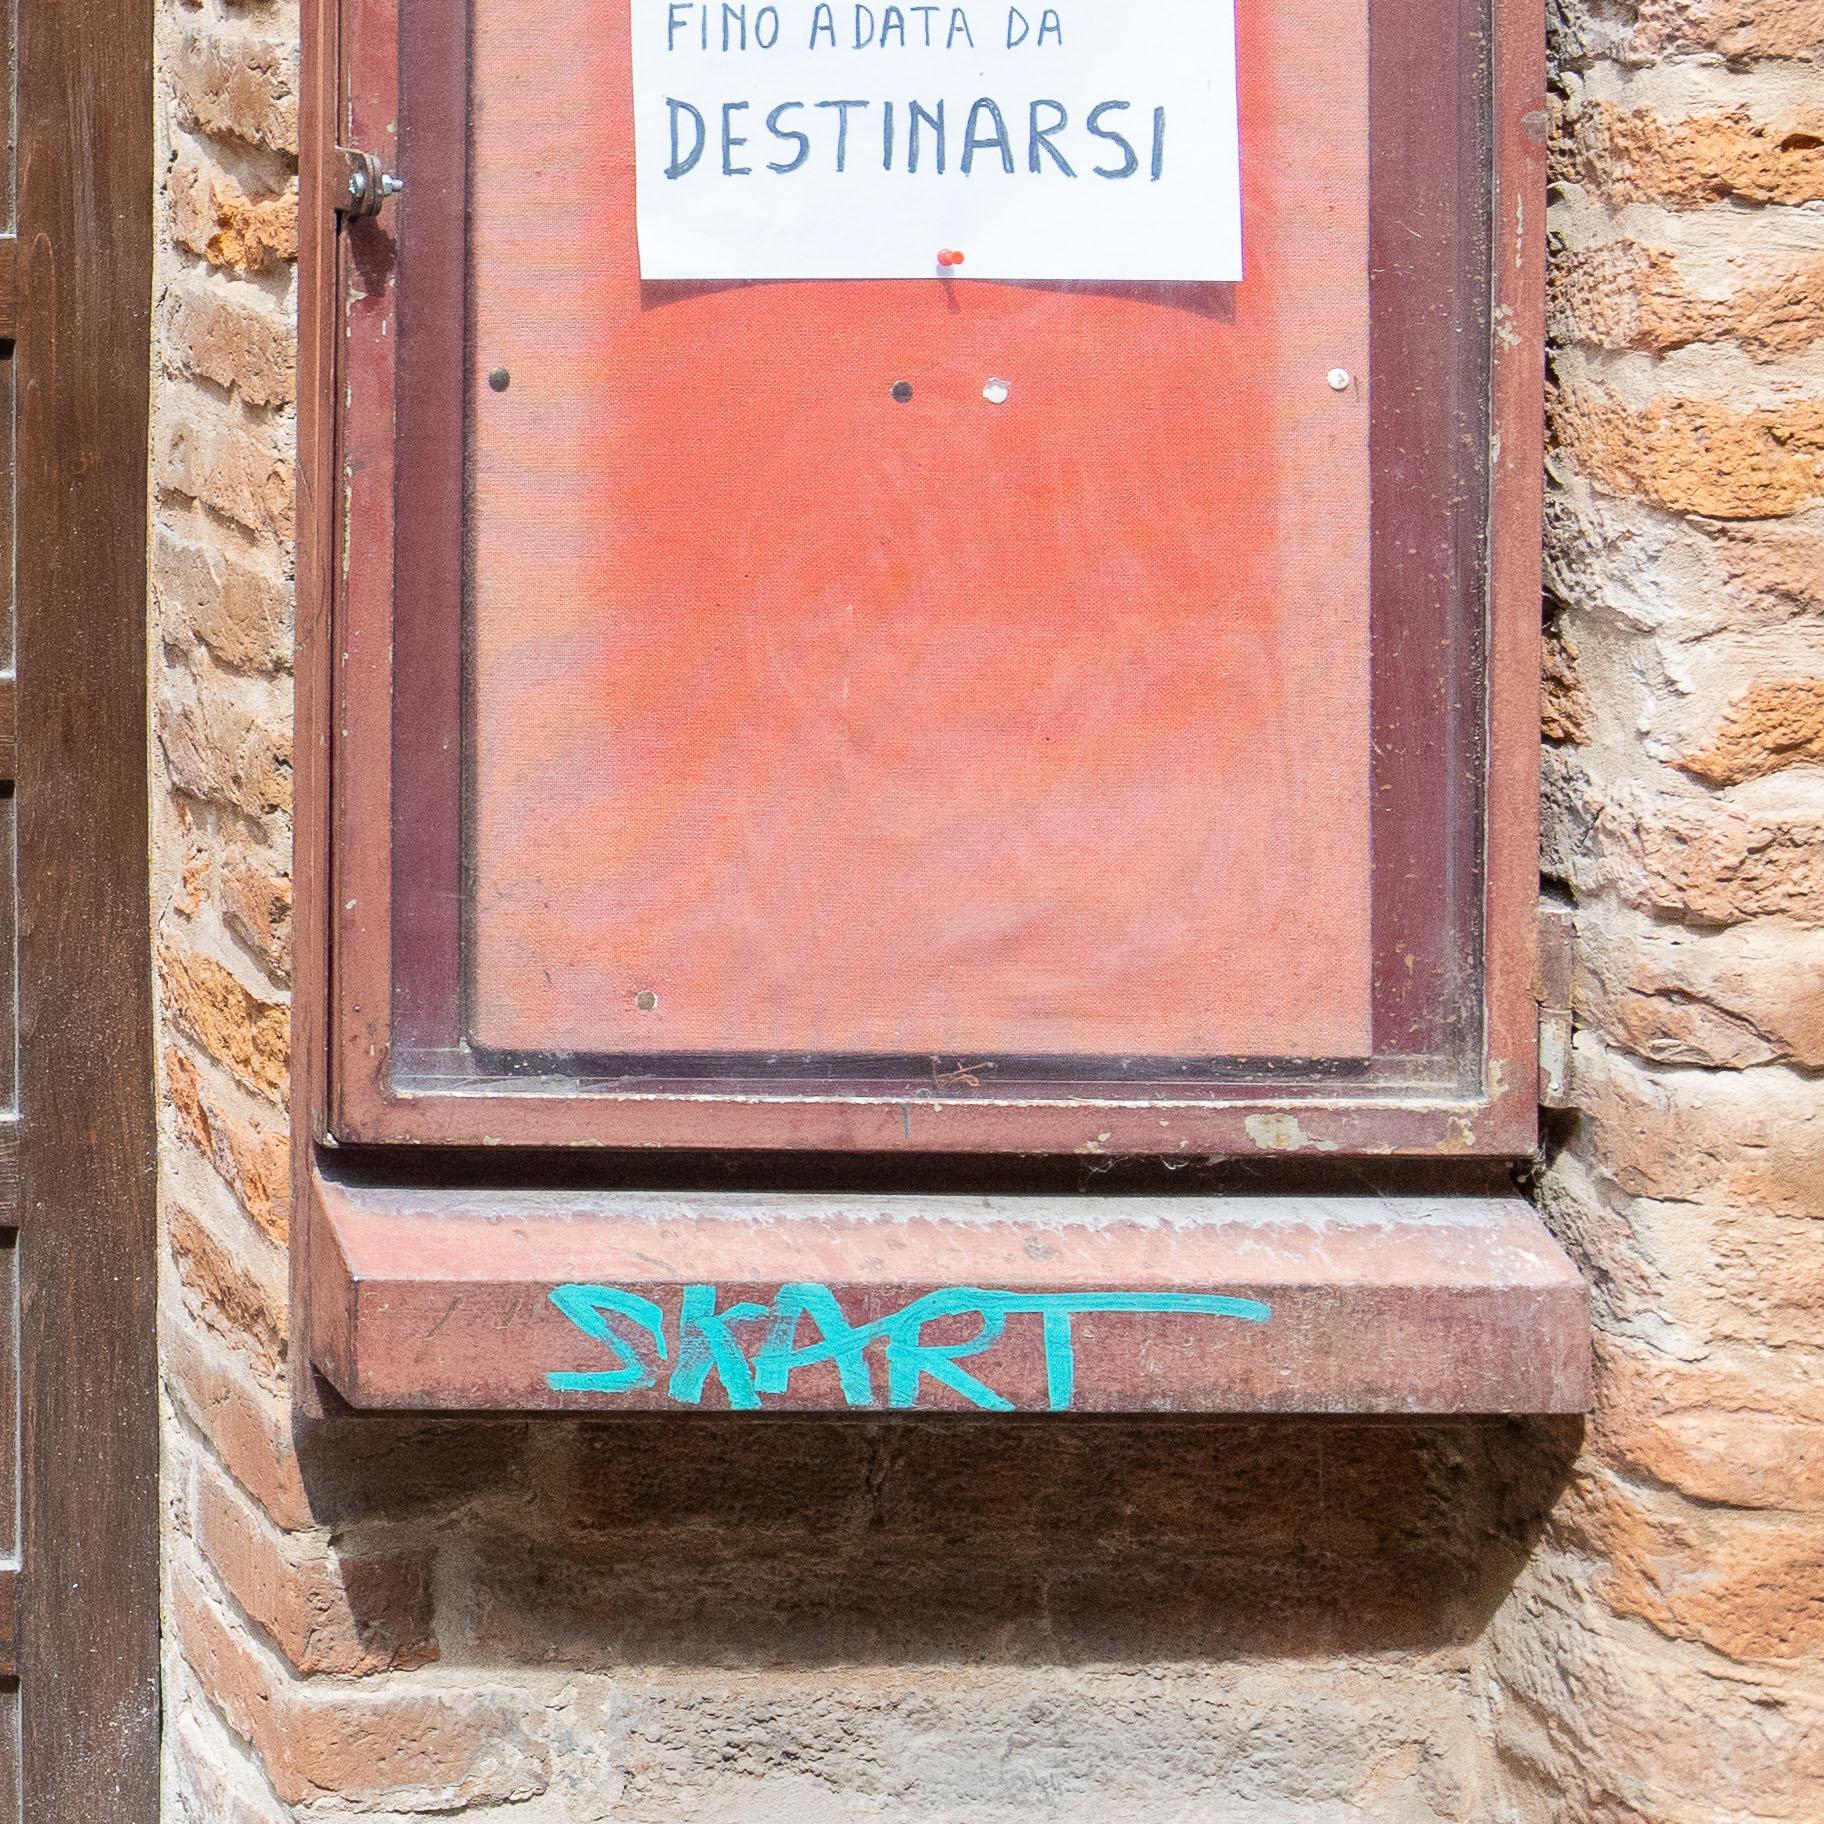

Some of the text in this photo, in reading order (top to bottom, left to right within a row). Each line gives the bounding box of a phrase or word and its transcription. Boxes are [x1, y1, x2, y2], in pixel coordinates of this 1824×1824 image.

[665, 1, 1064, 52] FINO A DATA DA
[662, 95, 1166, 182] DESTINARSI
